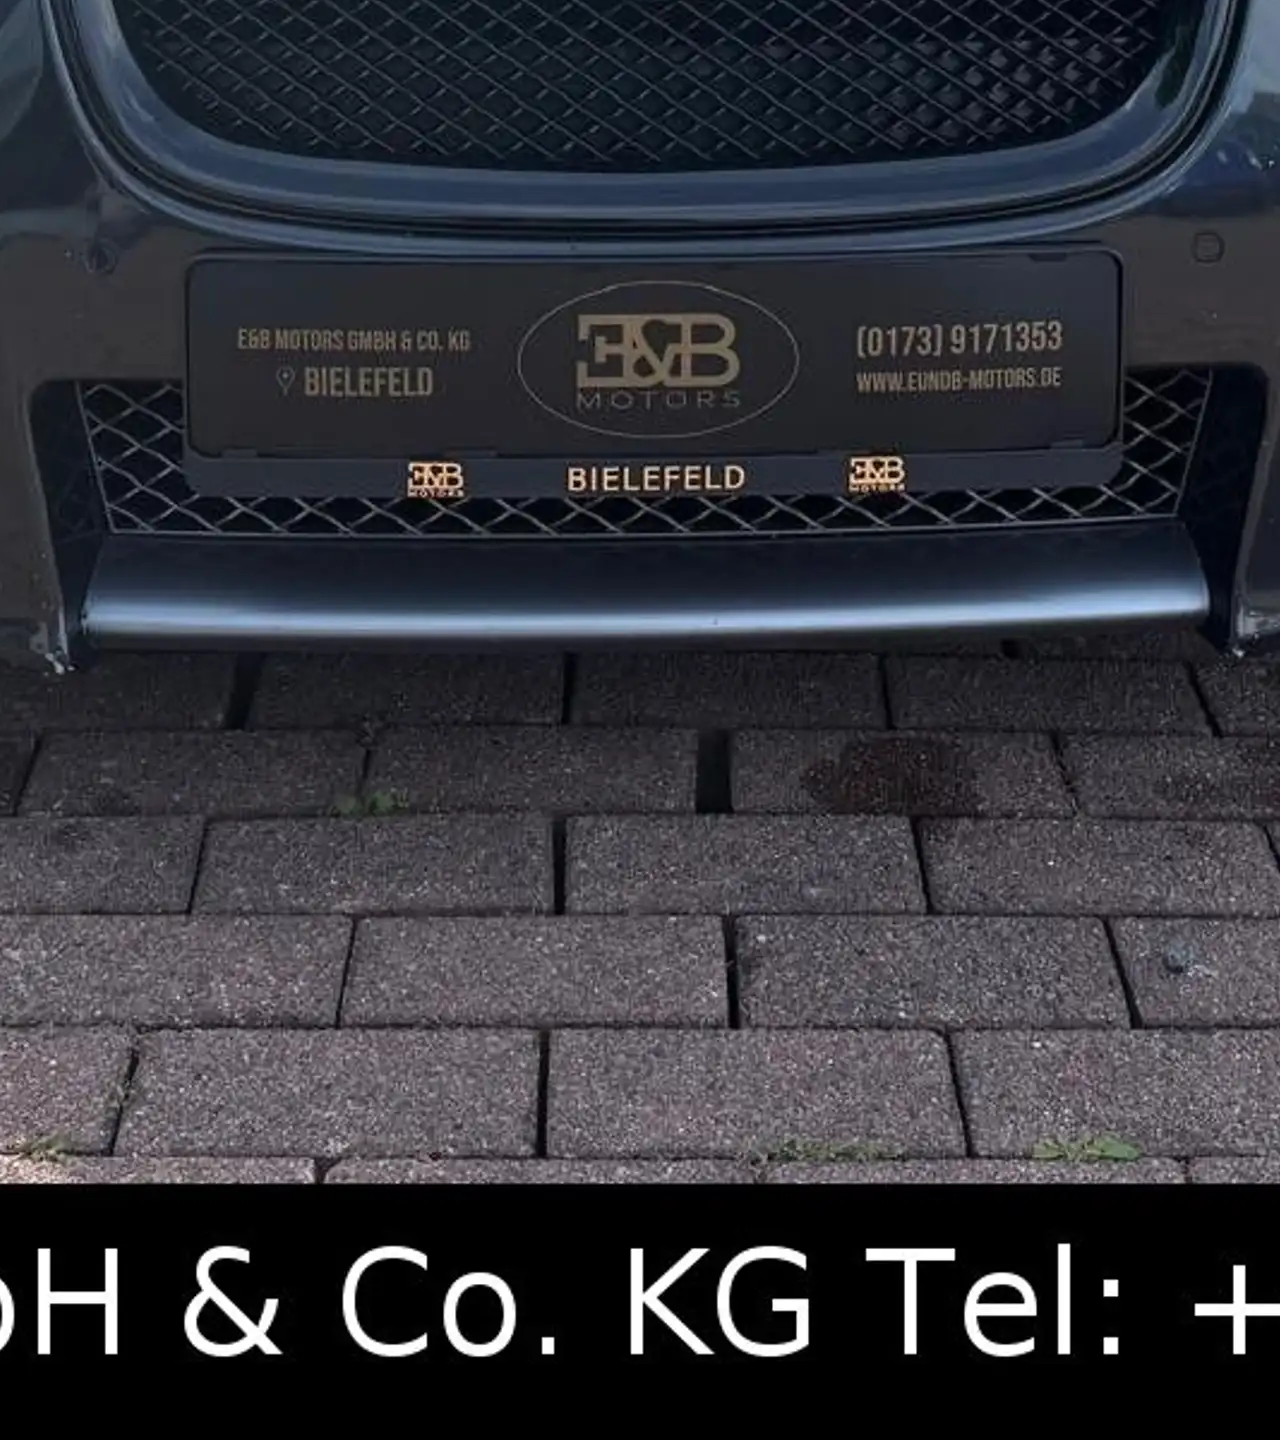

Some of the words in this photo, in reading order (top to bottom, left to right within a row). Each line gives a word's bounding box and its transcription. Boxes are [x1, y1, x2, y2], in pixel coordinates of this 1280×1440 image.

[237, 327, 271, 350] E&B
[274, 327, 345, 351] MOTORS
[347, 329, 396, 352] GMBH
[400, 329, 412, 352] &
[417, 329, 444, 352] CO.
[448, 329, 471, 352] KG
[577, 313, 740, 388] E&B
[856, 323, 943, 359] (0173)
[950, 320, 1063, 355] 9171353
[304, 366, 434, 398] BIELEFELD
[856, 366, 1063, 394] WWW.EUNDB-MOTORS.DE
[576, 390, 741, 411] MOTORS
[567, 464, 746, 492] BIELEFELD
